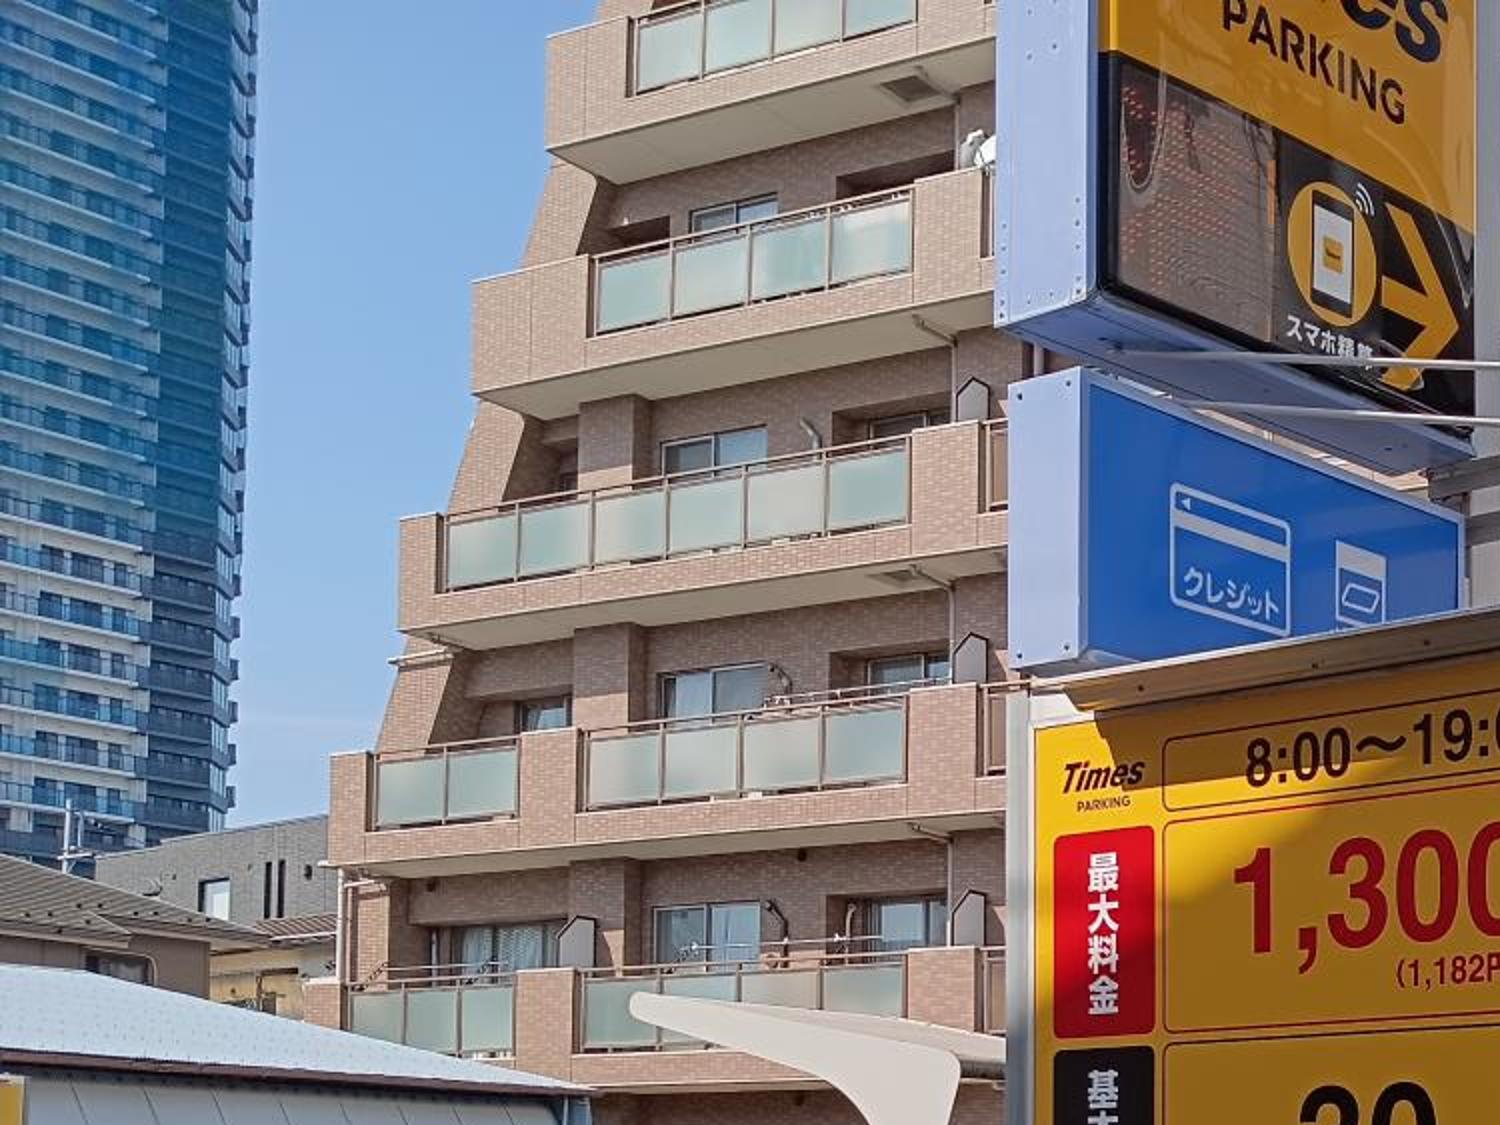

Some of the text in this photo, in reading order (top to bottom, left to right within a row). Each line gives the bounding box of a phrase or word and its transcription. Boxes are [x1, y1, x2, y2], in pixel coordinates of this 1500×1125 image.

[1222, 0, 1405, 125] PARKING
[1183, 565, 1280, 621] クレジット
[1062, 761, 1146, 794] Times
[1076, 795, 1131, 812] PARKING
[1086, 851, 1120, 1016] 最大料金
